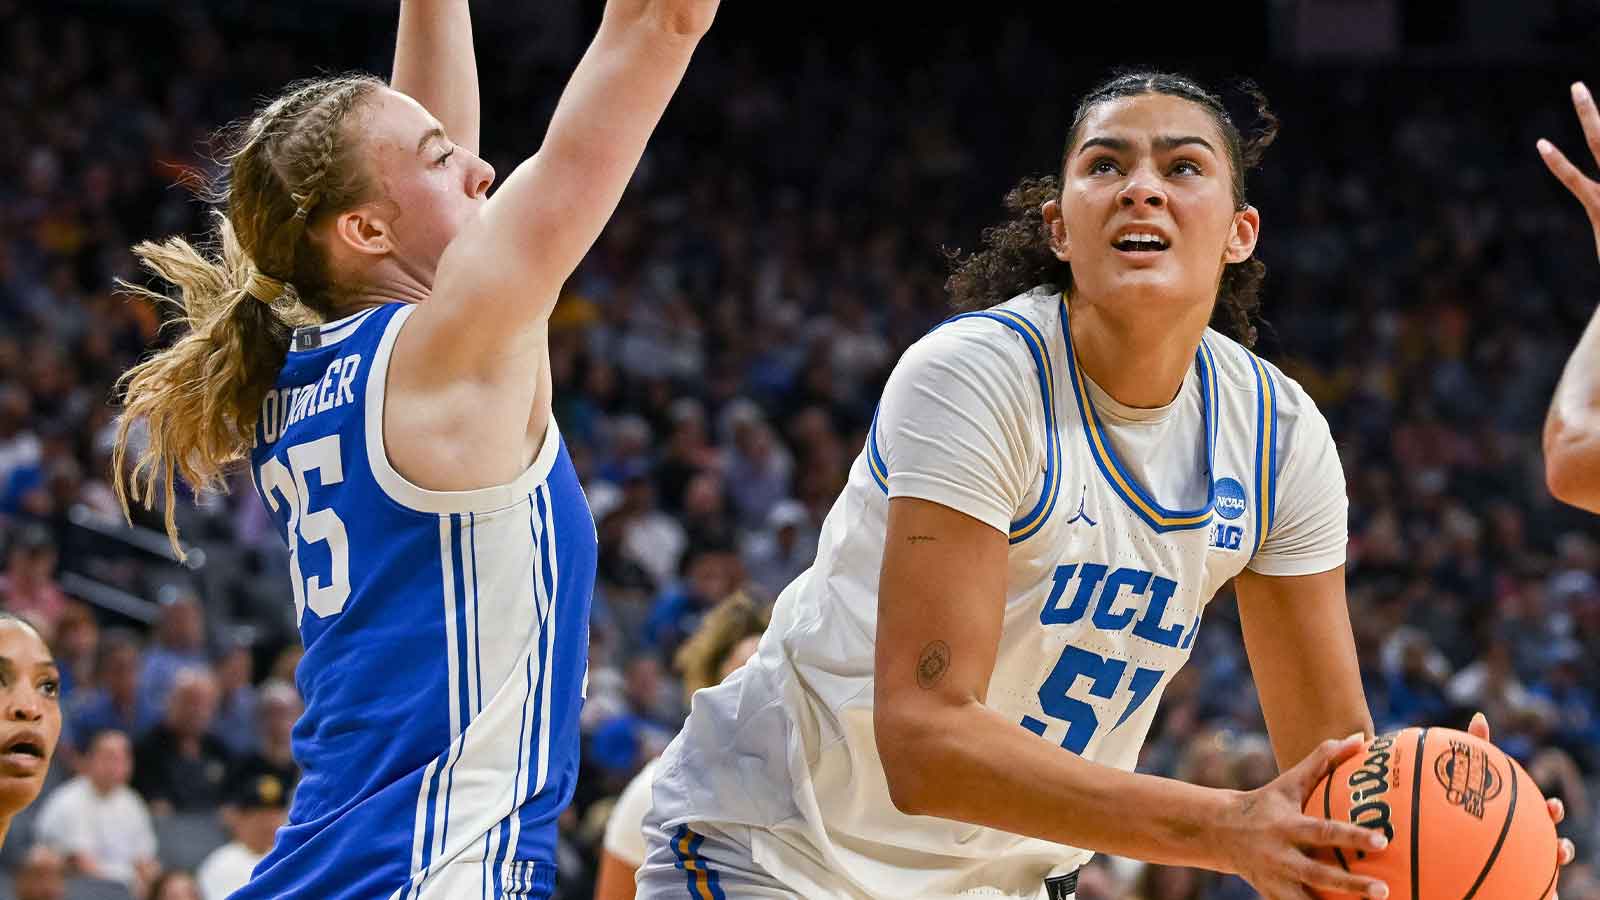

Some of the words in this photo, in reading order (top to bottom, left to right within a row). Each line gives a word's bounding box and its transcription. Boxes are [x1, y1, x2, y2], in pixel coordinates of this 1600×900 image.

[260, 434, 351, 628] 35
[1216, 496, 1245, 510] NCAA
[1039, 562, 1200, 650] UCL
